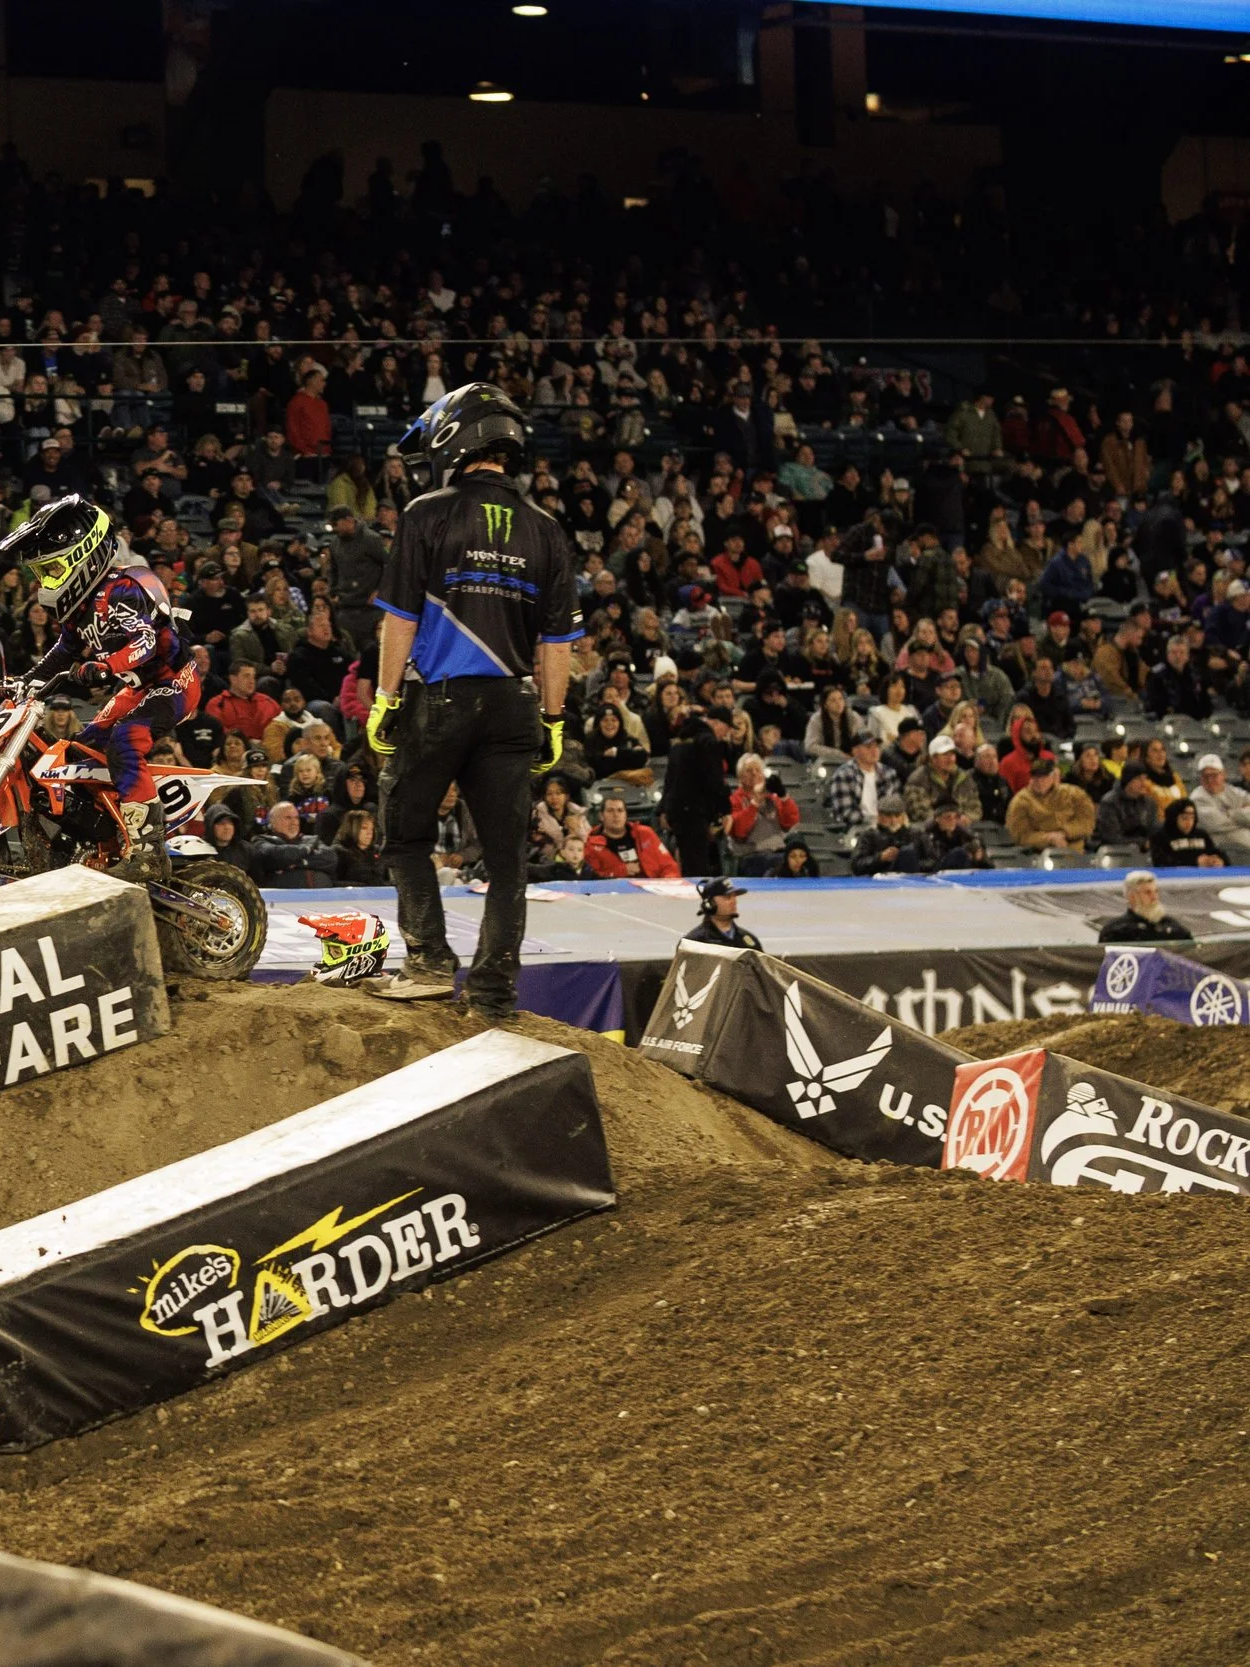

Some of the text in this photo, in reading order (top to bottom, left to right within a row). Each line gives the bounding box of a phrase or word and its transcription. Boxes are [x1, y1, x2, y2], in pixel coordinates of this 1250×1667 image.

[65, 526, 104, 568] 100%
[40, 770, 60, 779] KTM
[158, 779, 191, 815] 9
[346, 939, 382, 956] 100%
[672, 1041, 705, 1054] FORCE
[878, 1083, 948, 1143] U.S.
[152, 1253, 232, 1325] mike's
[193, 1193, 482, 1369] HARDER
